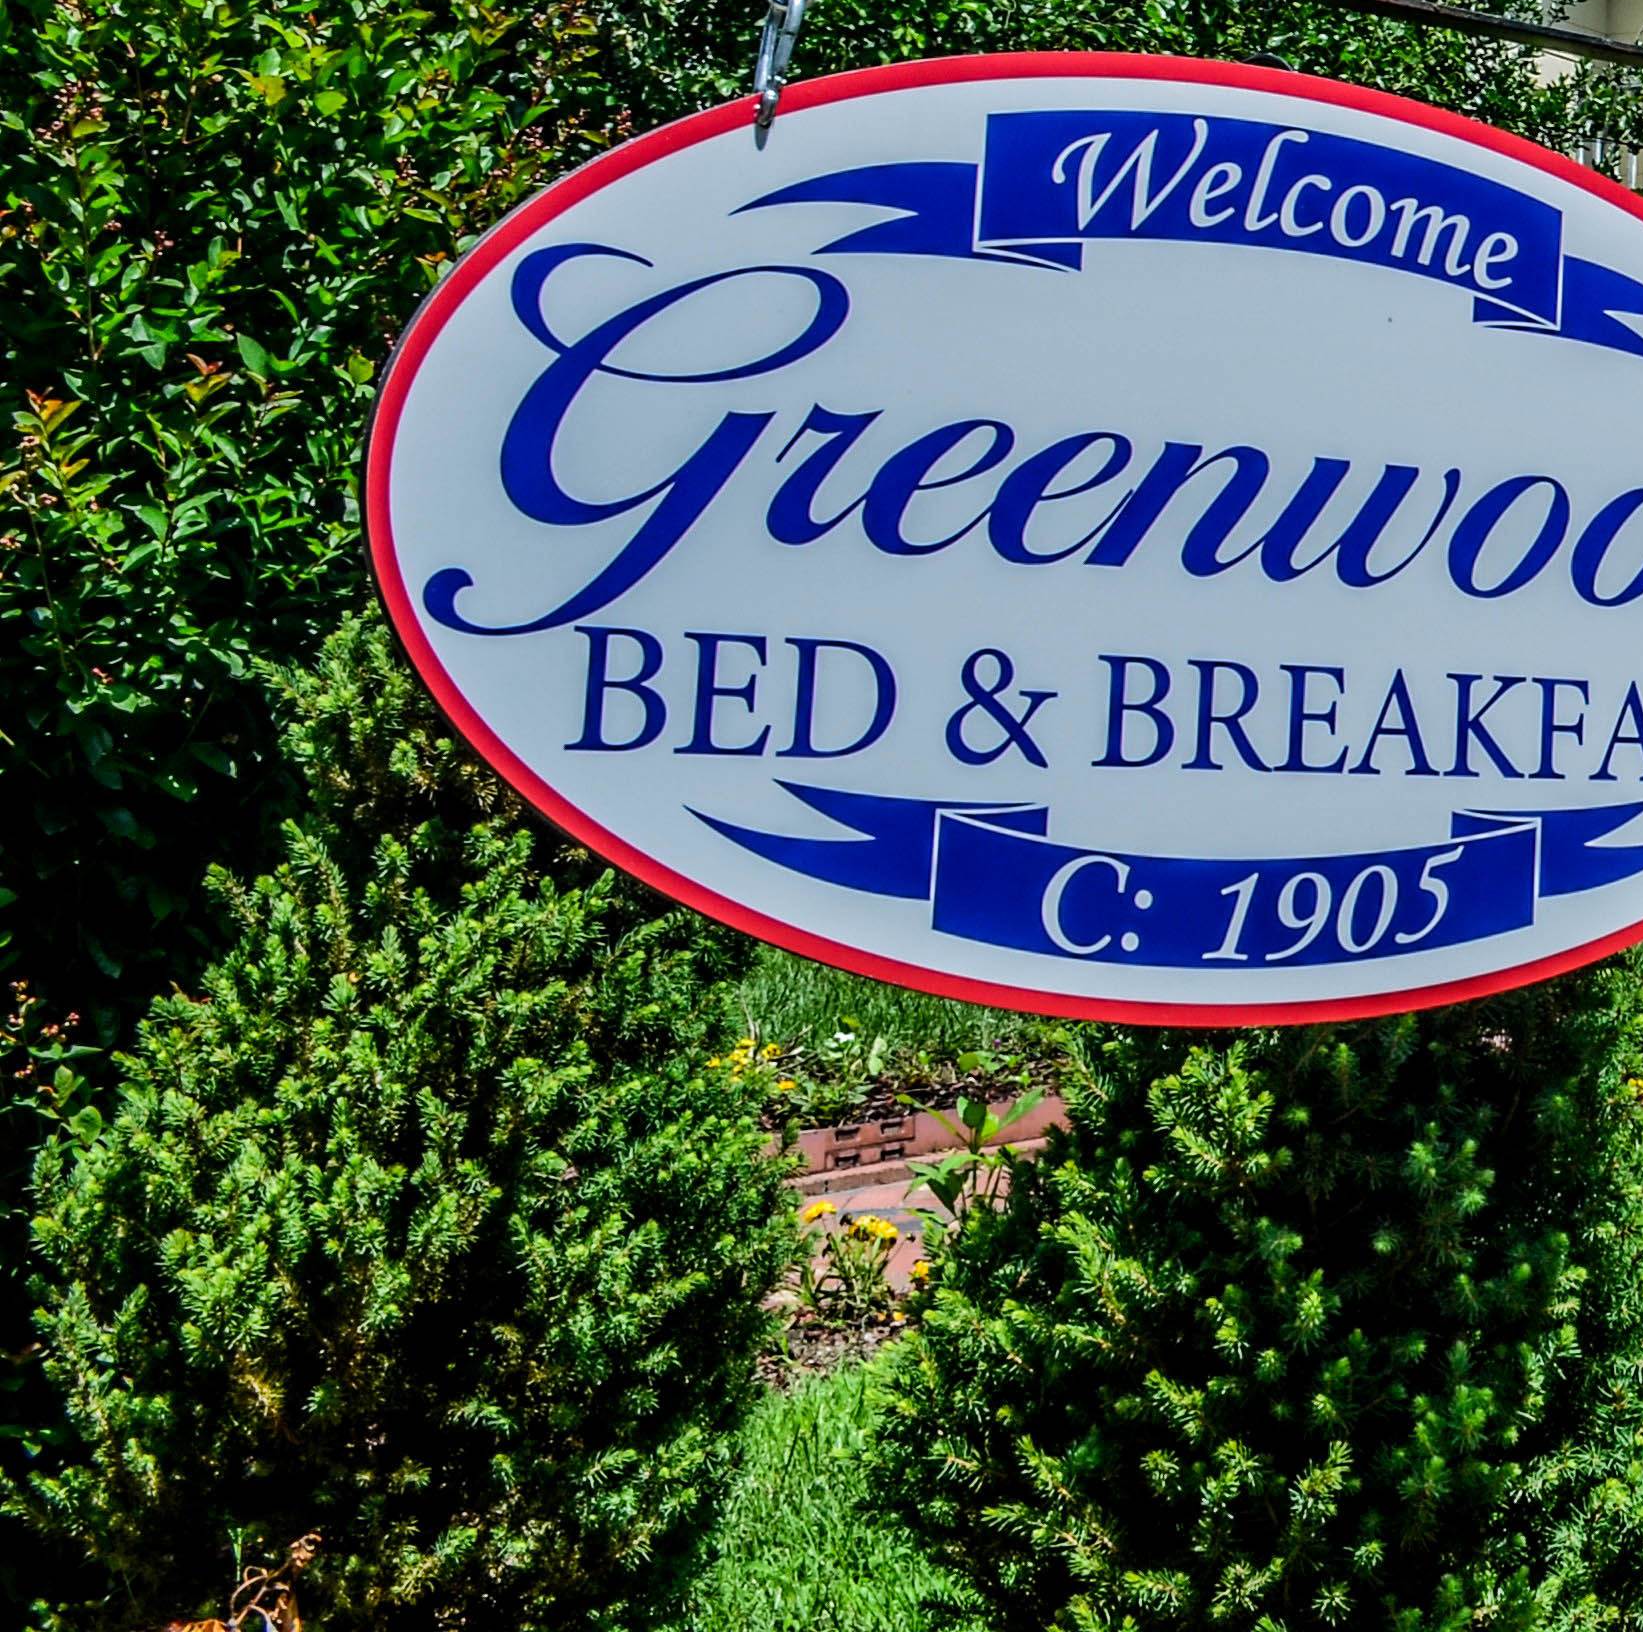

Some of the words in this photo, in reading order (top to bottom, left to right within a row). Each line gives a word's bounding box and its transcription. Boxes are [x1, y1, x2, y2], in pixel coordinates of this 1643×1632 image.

[1052, 119, 1518, 289] Welcome
[563, 625, 898, 759] BED
[945, 647, 1054, 769] &
[1042, 855, 1152, 954] C:
[1202, 845, 1464, 961] 1905
